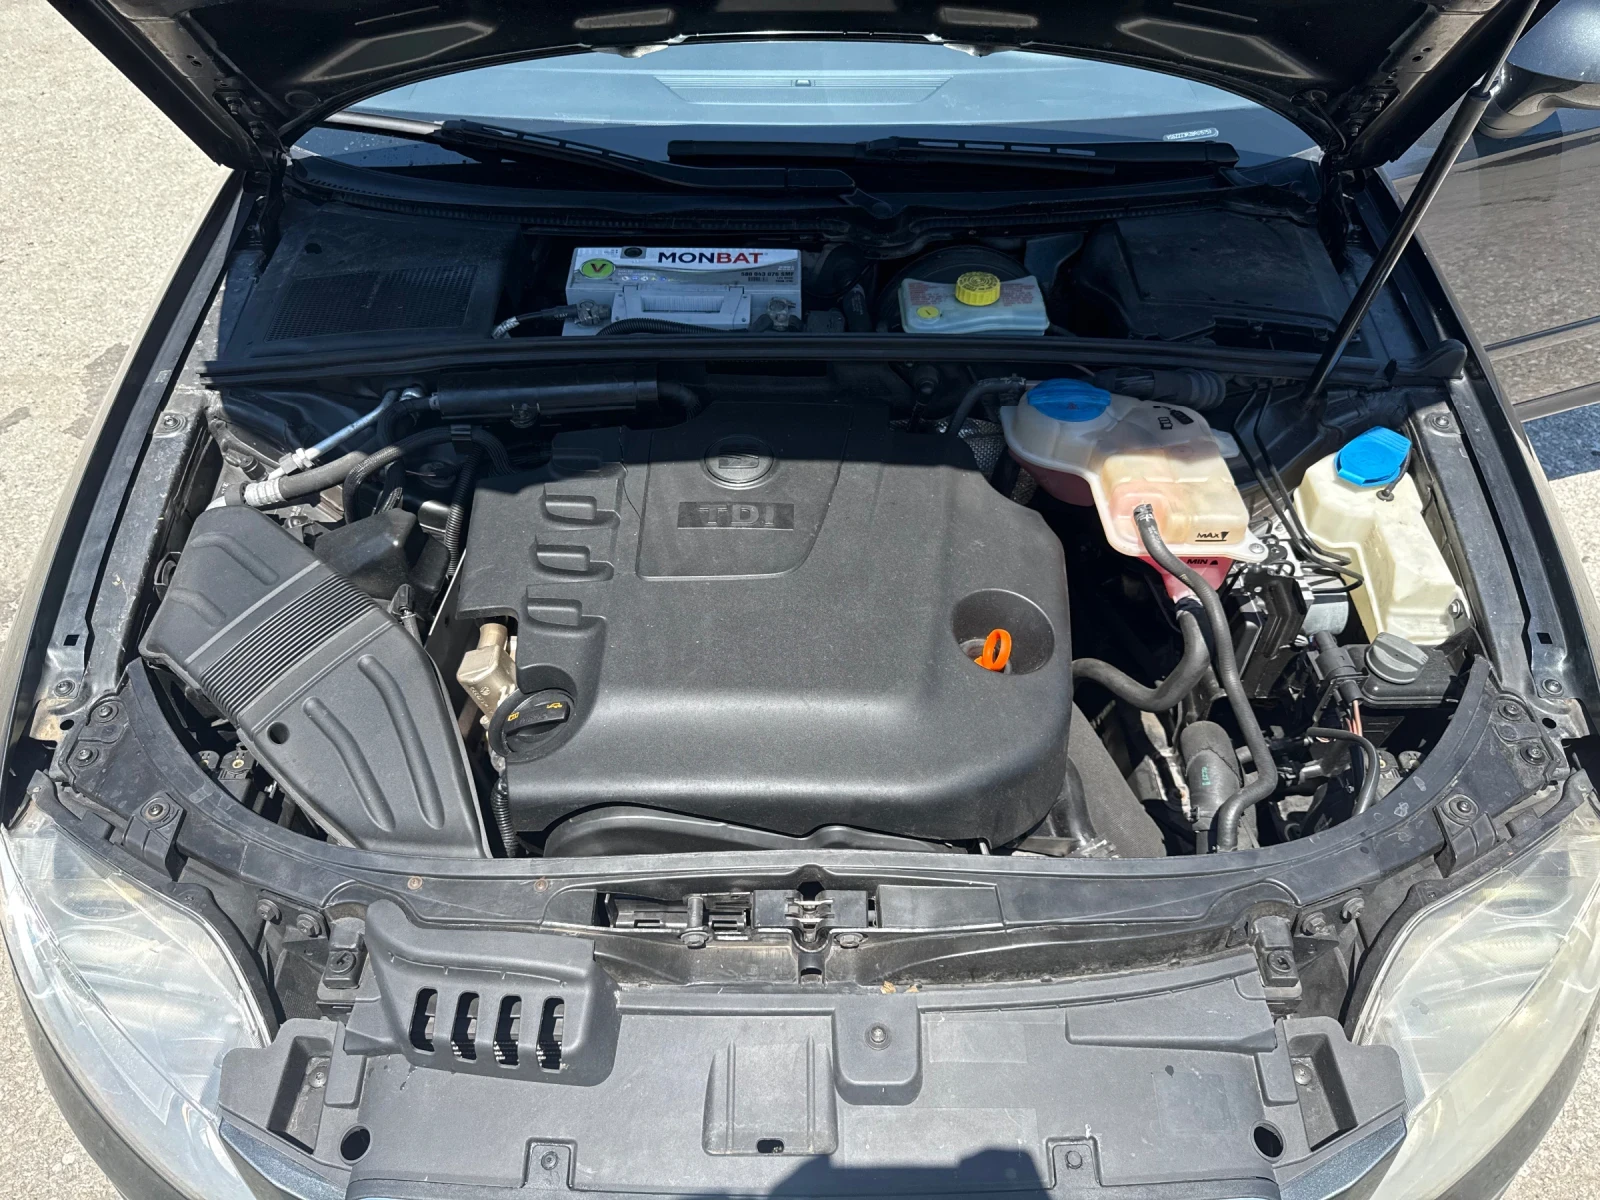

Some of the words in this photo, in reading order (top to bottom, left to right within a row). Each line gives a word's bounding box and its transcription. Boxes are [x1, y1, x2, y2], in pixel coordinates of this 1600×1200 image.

[658, 252, 763, 264] MONBAT
[590, 263, 608, 273] V
[698, 504, 775, 527] TDI
